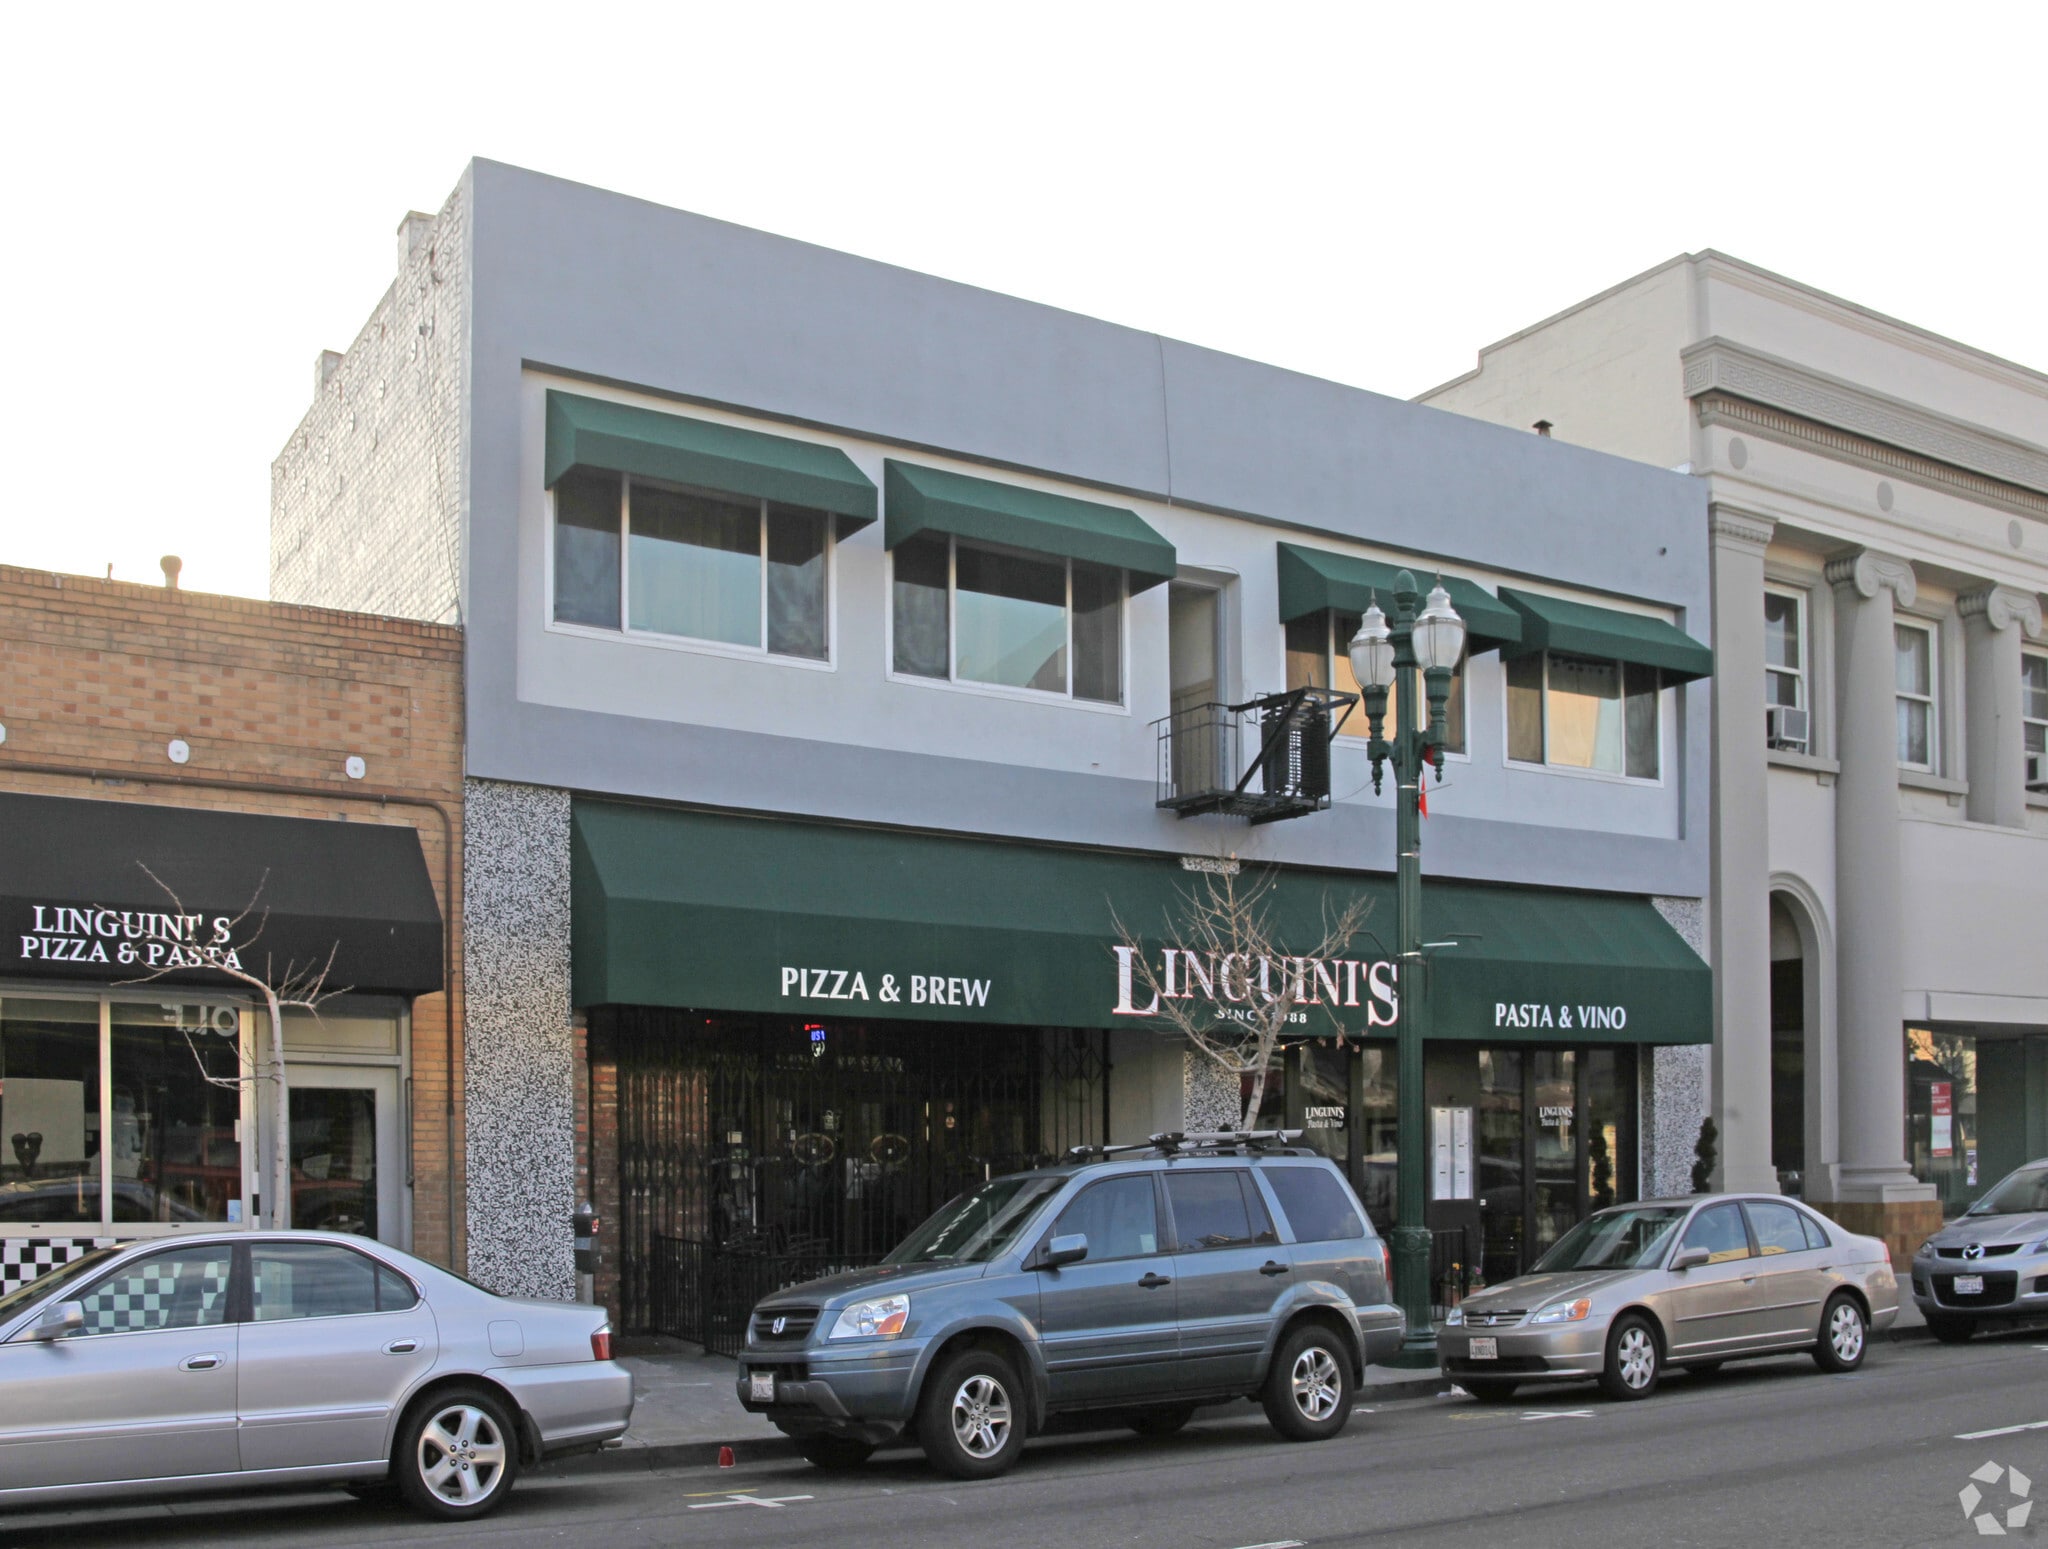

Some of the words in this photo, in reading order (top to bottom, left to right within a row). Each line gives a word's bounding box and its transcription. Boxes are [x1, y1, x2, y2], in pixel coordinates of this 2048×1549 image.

[20, 935, 110, 963] PIZZA
[117, 942, 139, 964] &
[147, 943, 243, 970] PASTA
[781, 966, 870, 1001] PIZZA
[878, 973, 901, 1003] &
[910, 974, 991, 1008] BREW
[1112, 945, 1399, 1027] LINGUINI'S
[1217, 1008, 1264, 1022] SINC
[1272, 1011, 1307, 1024] 88
[1495, 1002, 1554, 1028] PASTA
[1559, 1005, 1573, 1028] &
[1577, 1005, 1627, 1030] VINO
